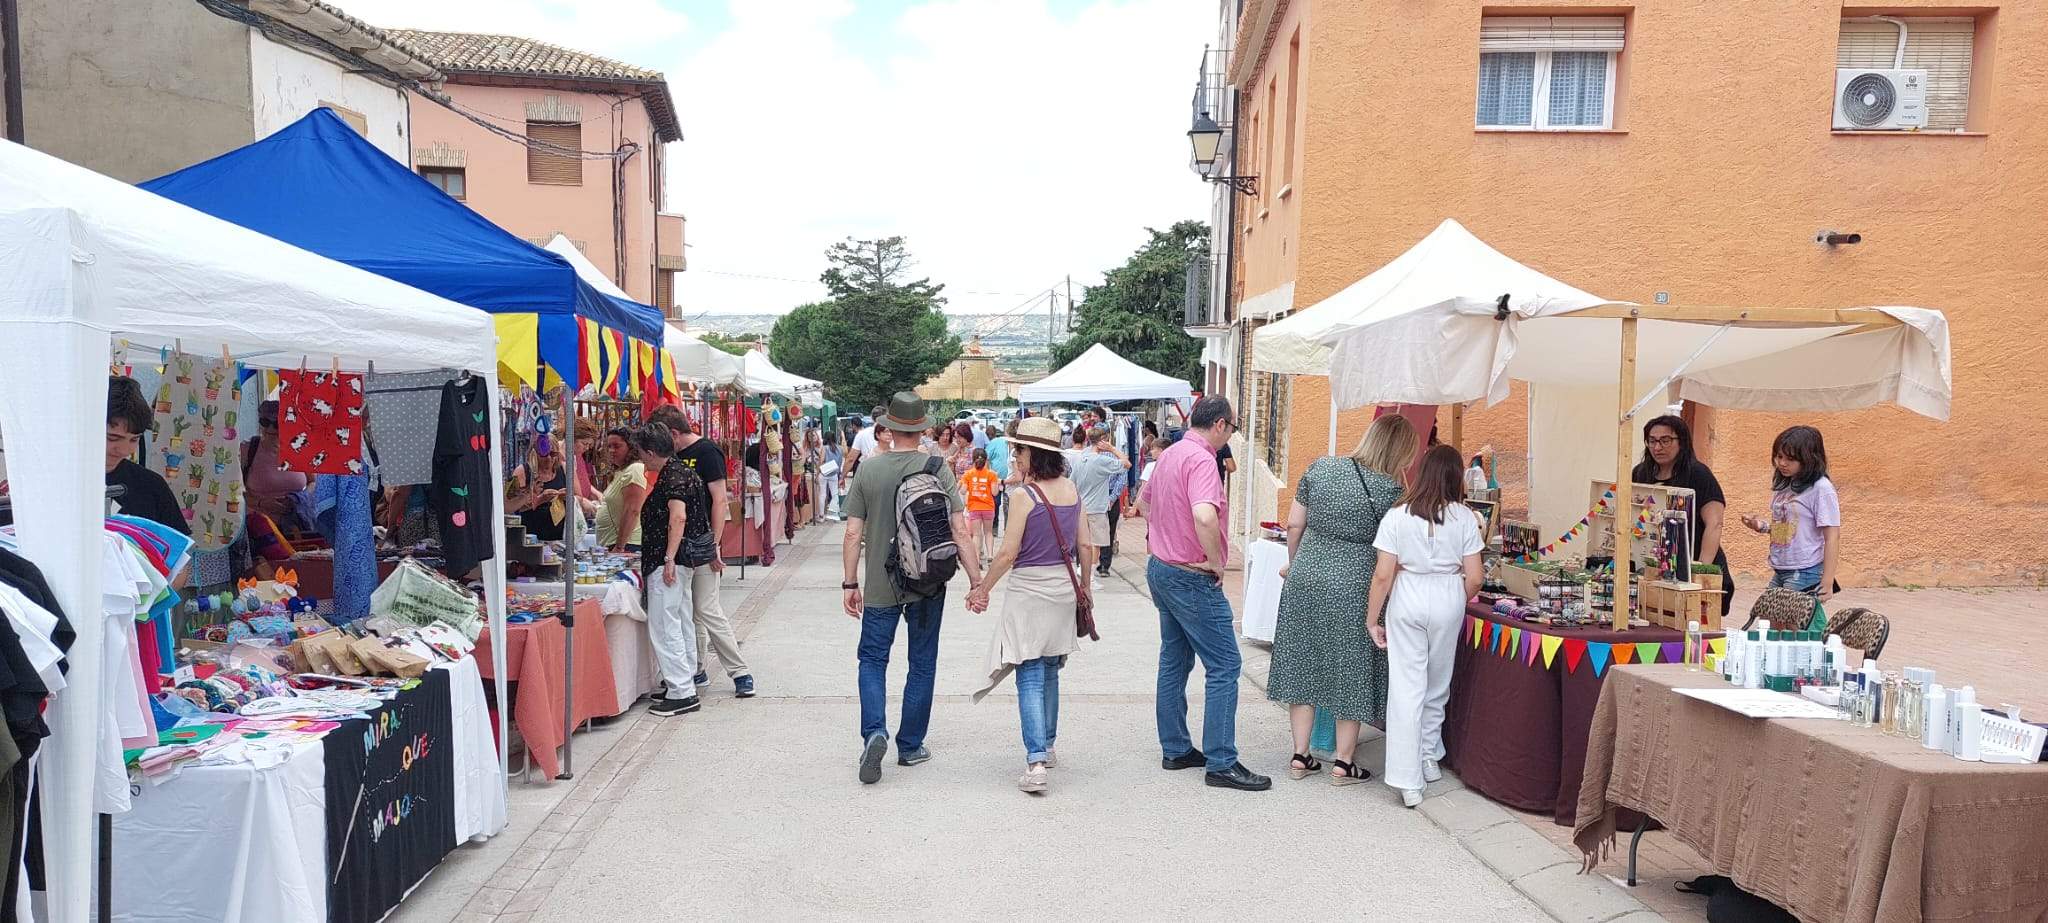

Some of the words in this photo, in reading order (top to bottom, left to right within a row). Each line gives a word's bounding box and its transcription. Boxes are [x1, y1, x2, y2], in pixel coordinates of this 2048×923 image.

[363, 709, 401, 754] MIRA
[402, 732, 428, 770] QUE
[373, 793, 410, 843] MAJO
